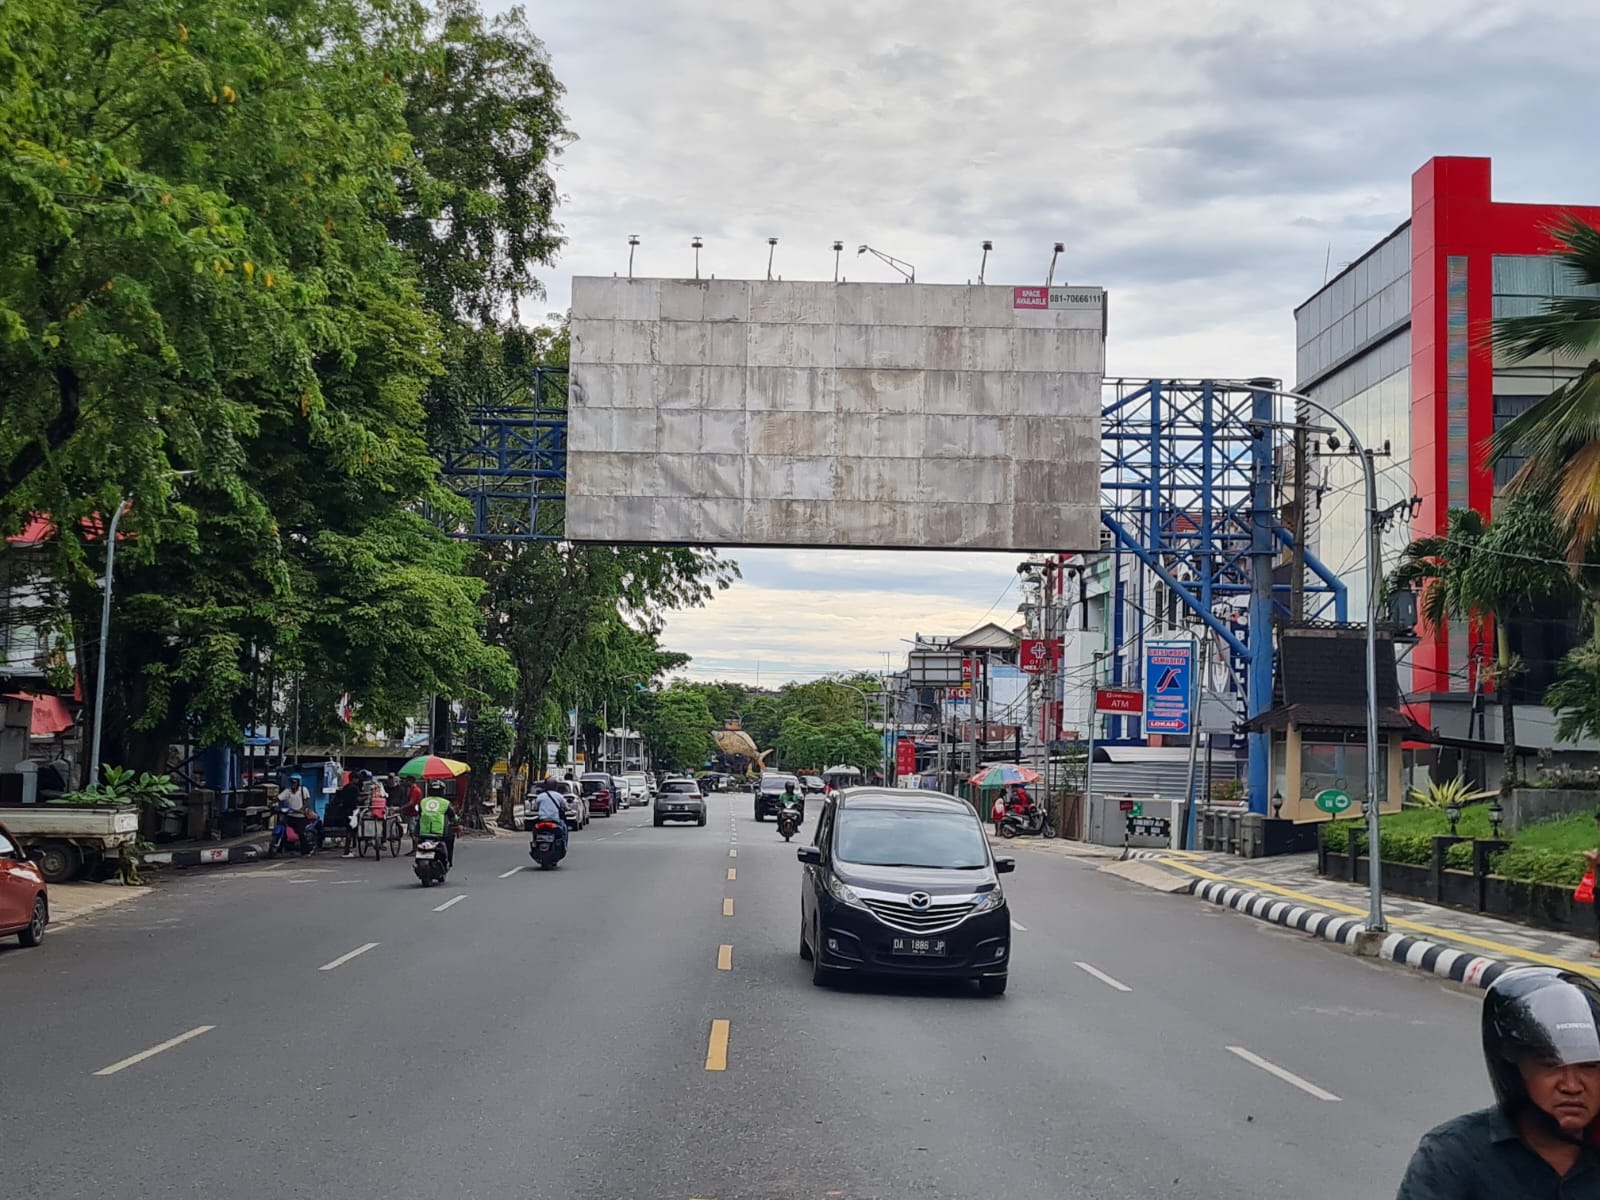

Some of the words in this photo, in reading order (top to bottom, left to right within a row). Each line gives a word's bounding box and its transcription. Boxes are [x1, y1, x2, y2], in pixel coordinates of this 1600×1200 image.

[1016, 297, 1047, 305] AVAILABLE
[1111, 700, 1129, 709] ATM
[893, 939, 904, 949] DA
[934, 941, 945, 951] JP
[1556, 1022, 1592, 1030] HONDA
